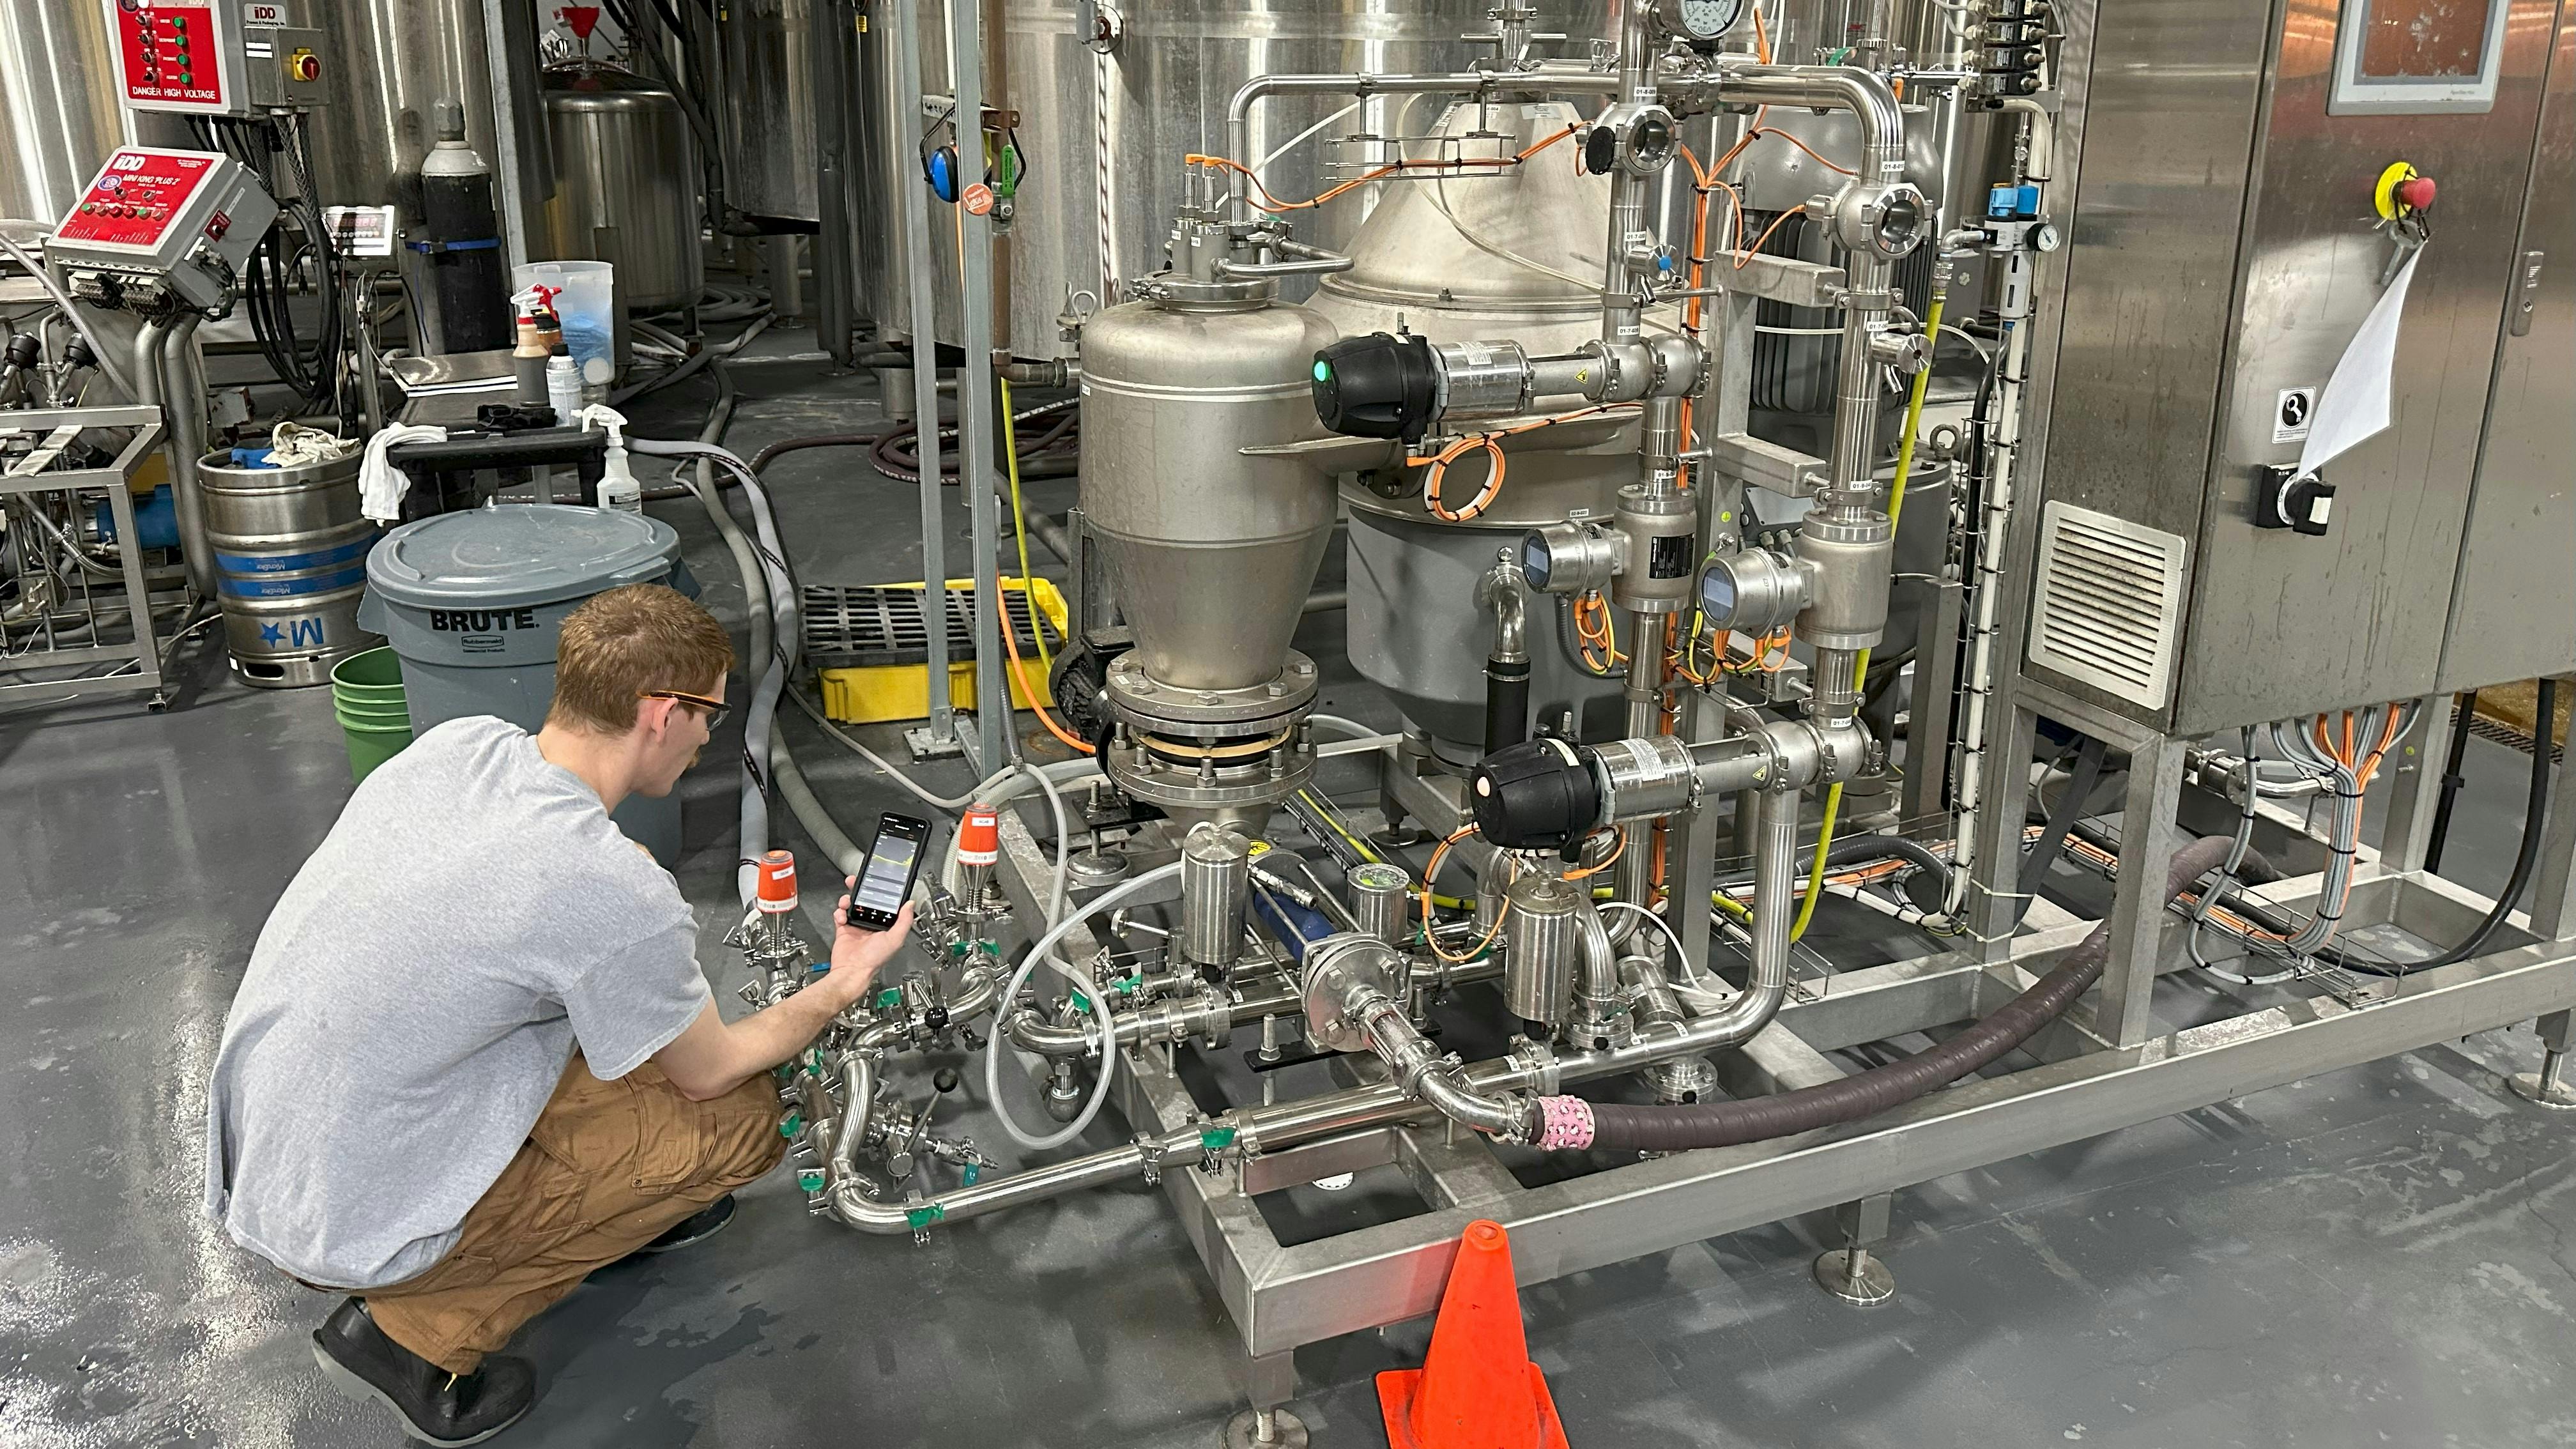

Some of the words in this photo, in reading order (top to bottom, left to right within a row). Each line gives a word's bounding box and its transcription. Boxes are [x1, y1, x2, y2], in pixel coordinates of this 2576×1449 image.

[132, 86, 162, 96] DANGER
[164, 88, 181, 98] HIGH
[184, 89, 216, 99] VOLTAGE
[112, 155, 146, 171] iDD
[137, 175, 154, 183] KING
